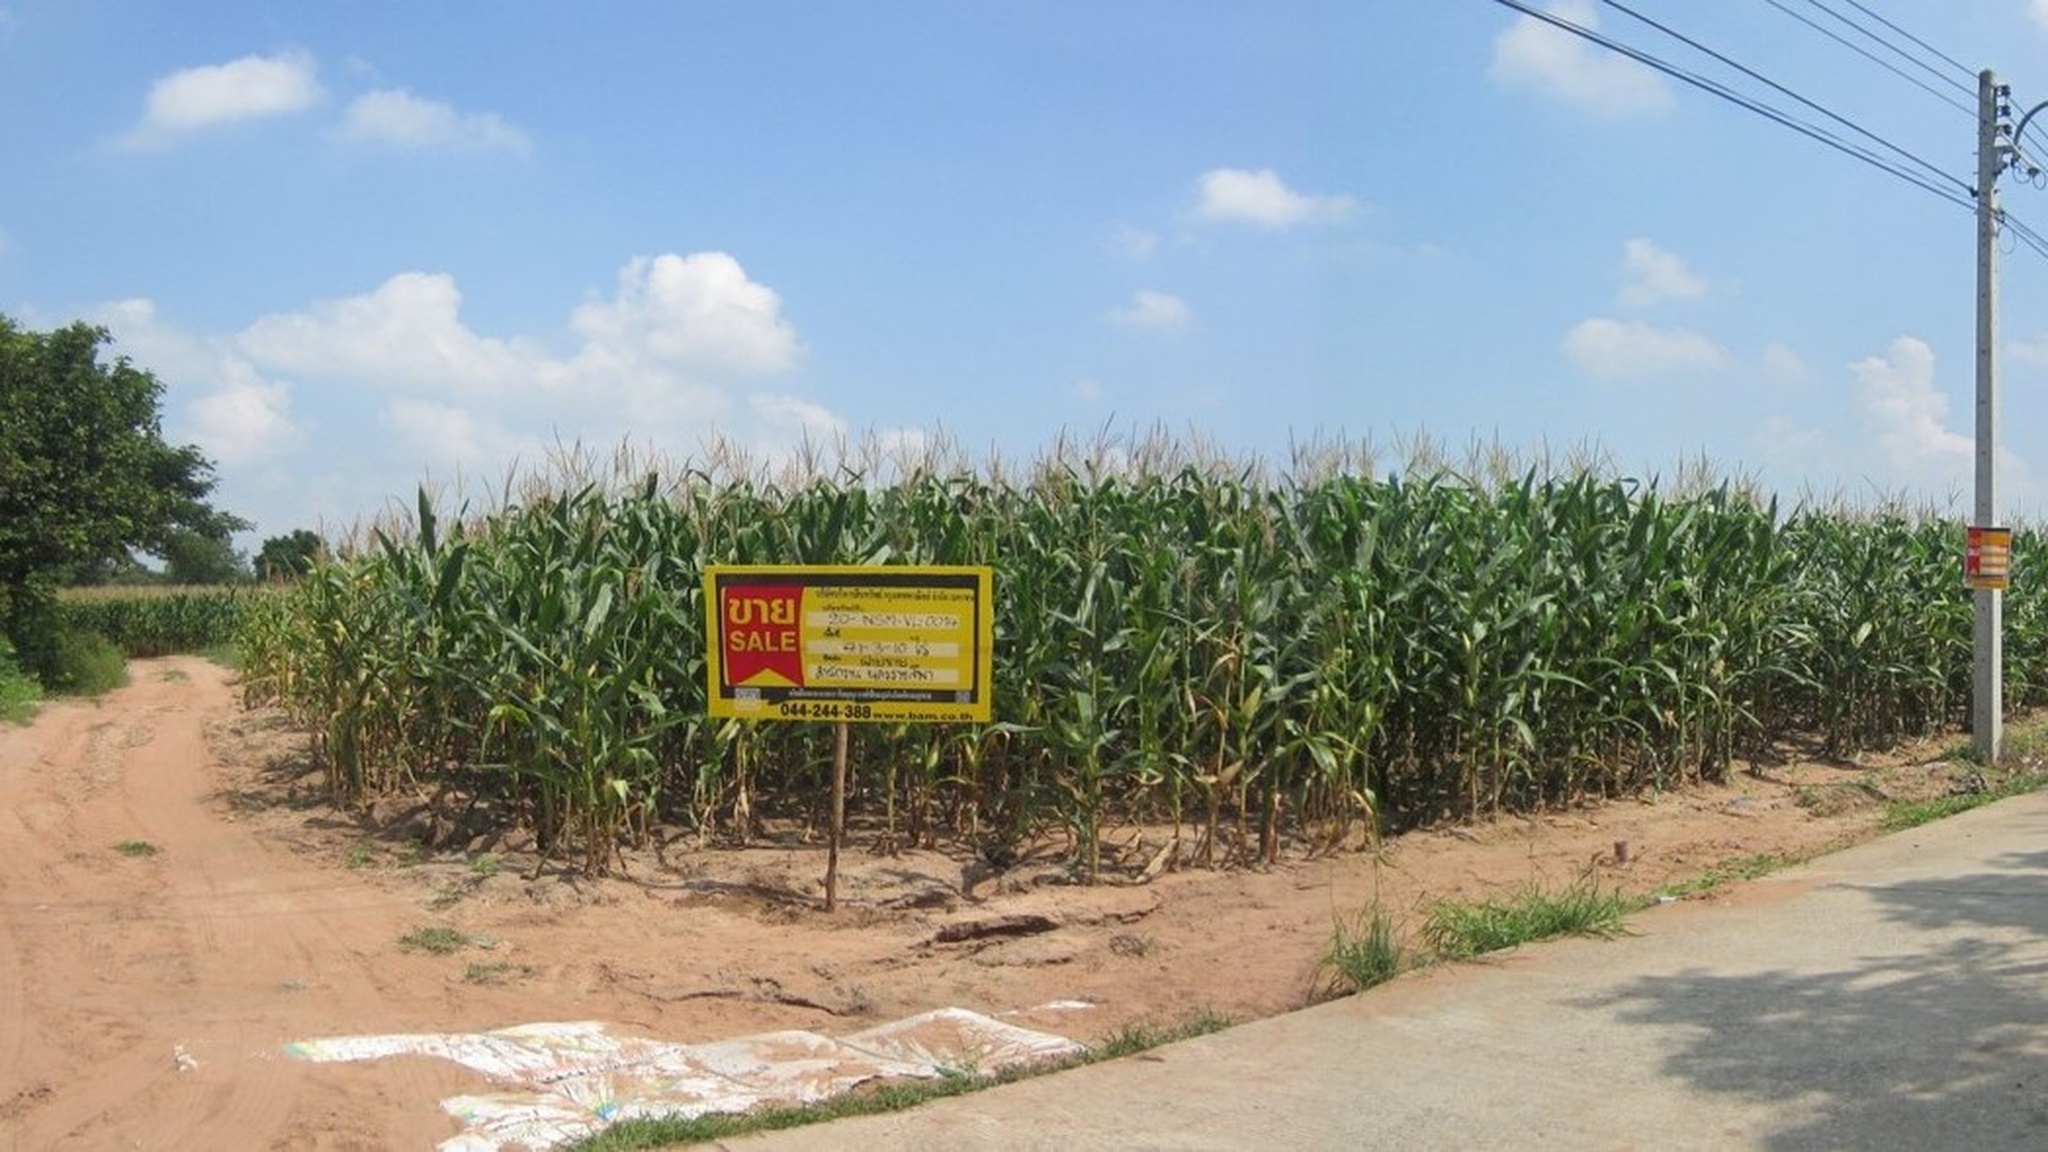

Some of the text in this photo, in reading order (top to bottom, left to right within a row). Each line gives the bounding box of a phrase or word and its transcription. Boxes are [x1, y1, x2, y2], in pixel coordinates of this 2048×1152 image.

[729, 598, 795, 625] ขาย
[729, 630, 797, 652] SALE
[780, 703, 973, 721] 044-244-388 www.bam.co.th
